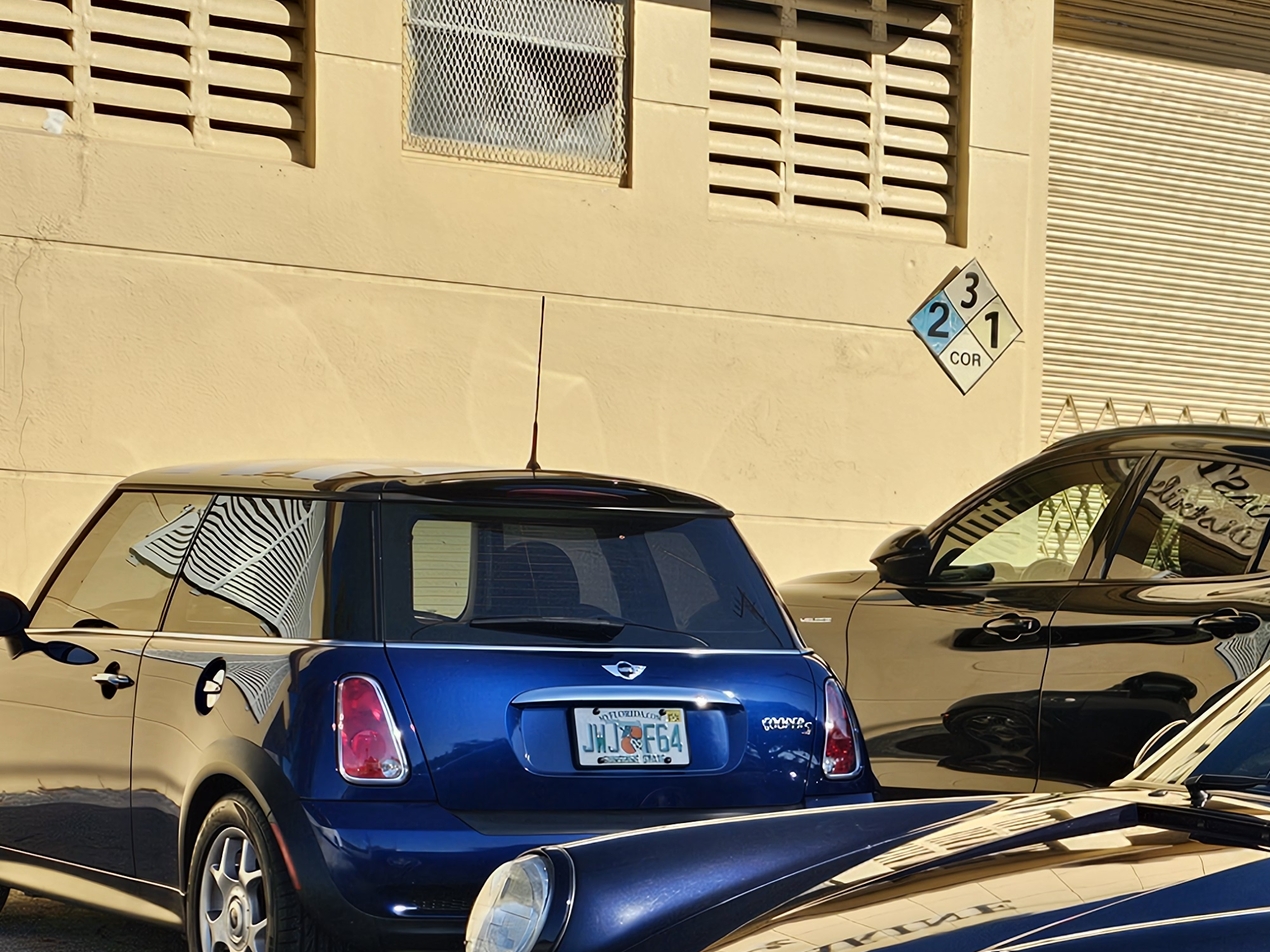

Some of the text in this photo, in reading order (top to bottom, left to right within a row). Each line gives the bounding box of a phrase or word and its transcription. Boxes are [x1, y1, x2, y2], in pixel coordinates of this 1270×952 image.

[960, 271, 980, 309] 3
[927, 301, 950, 339] 2
[984, 310, 999, 349] 1
[949, 351, 981, 367] COR
[582, 723, 683, 754] JWJ F64
